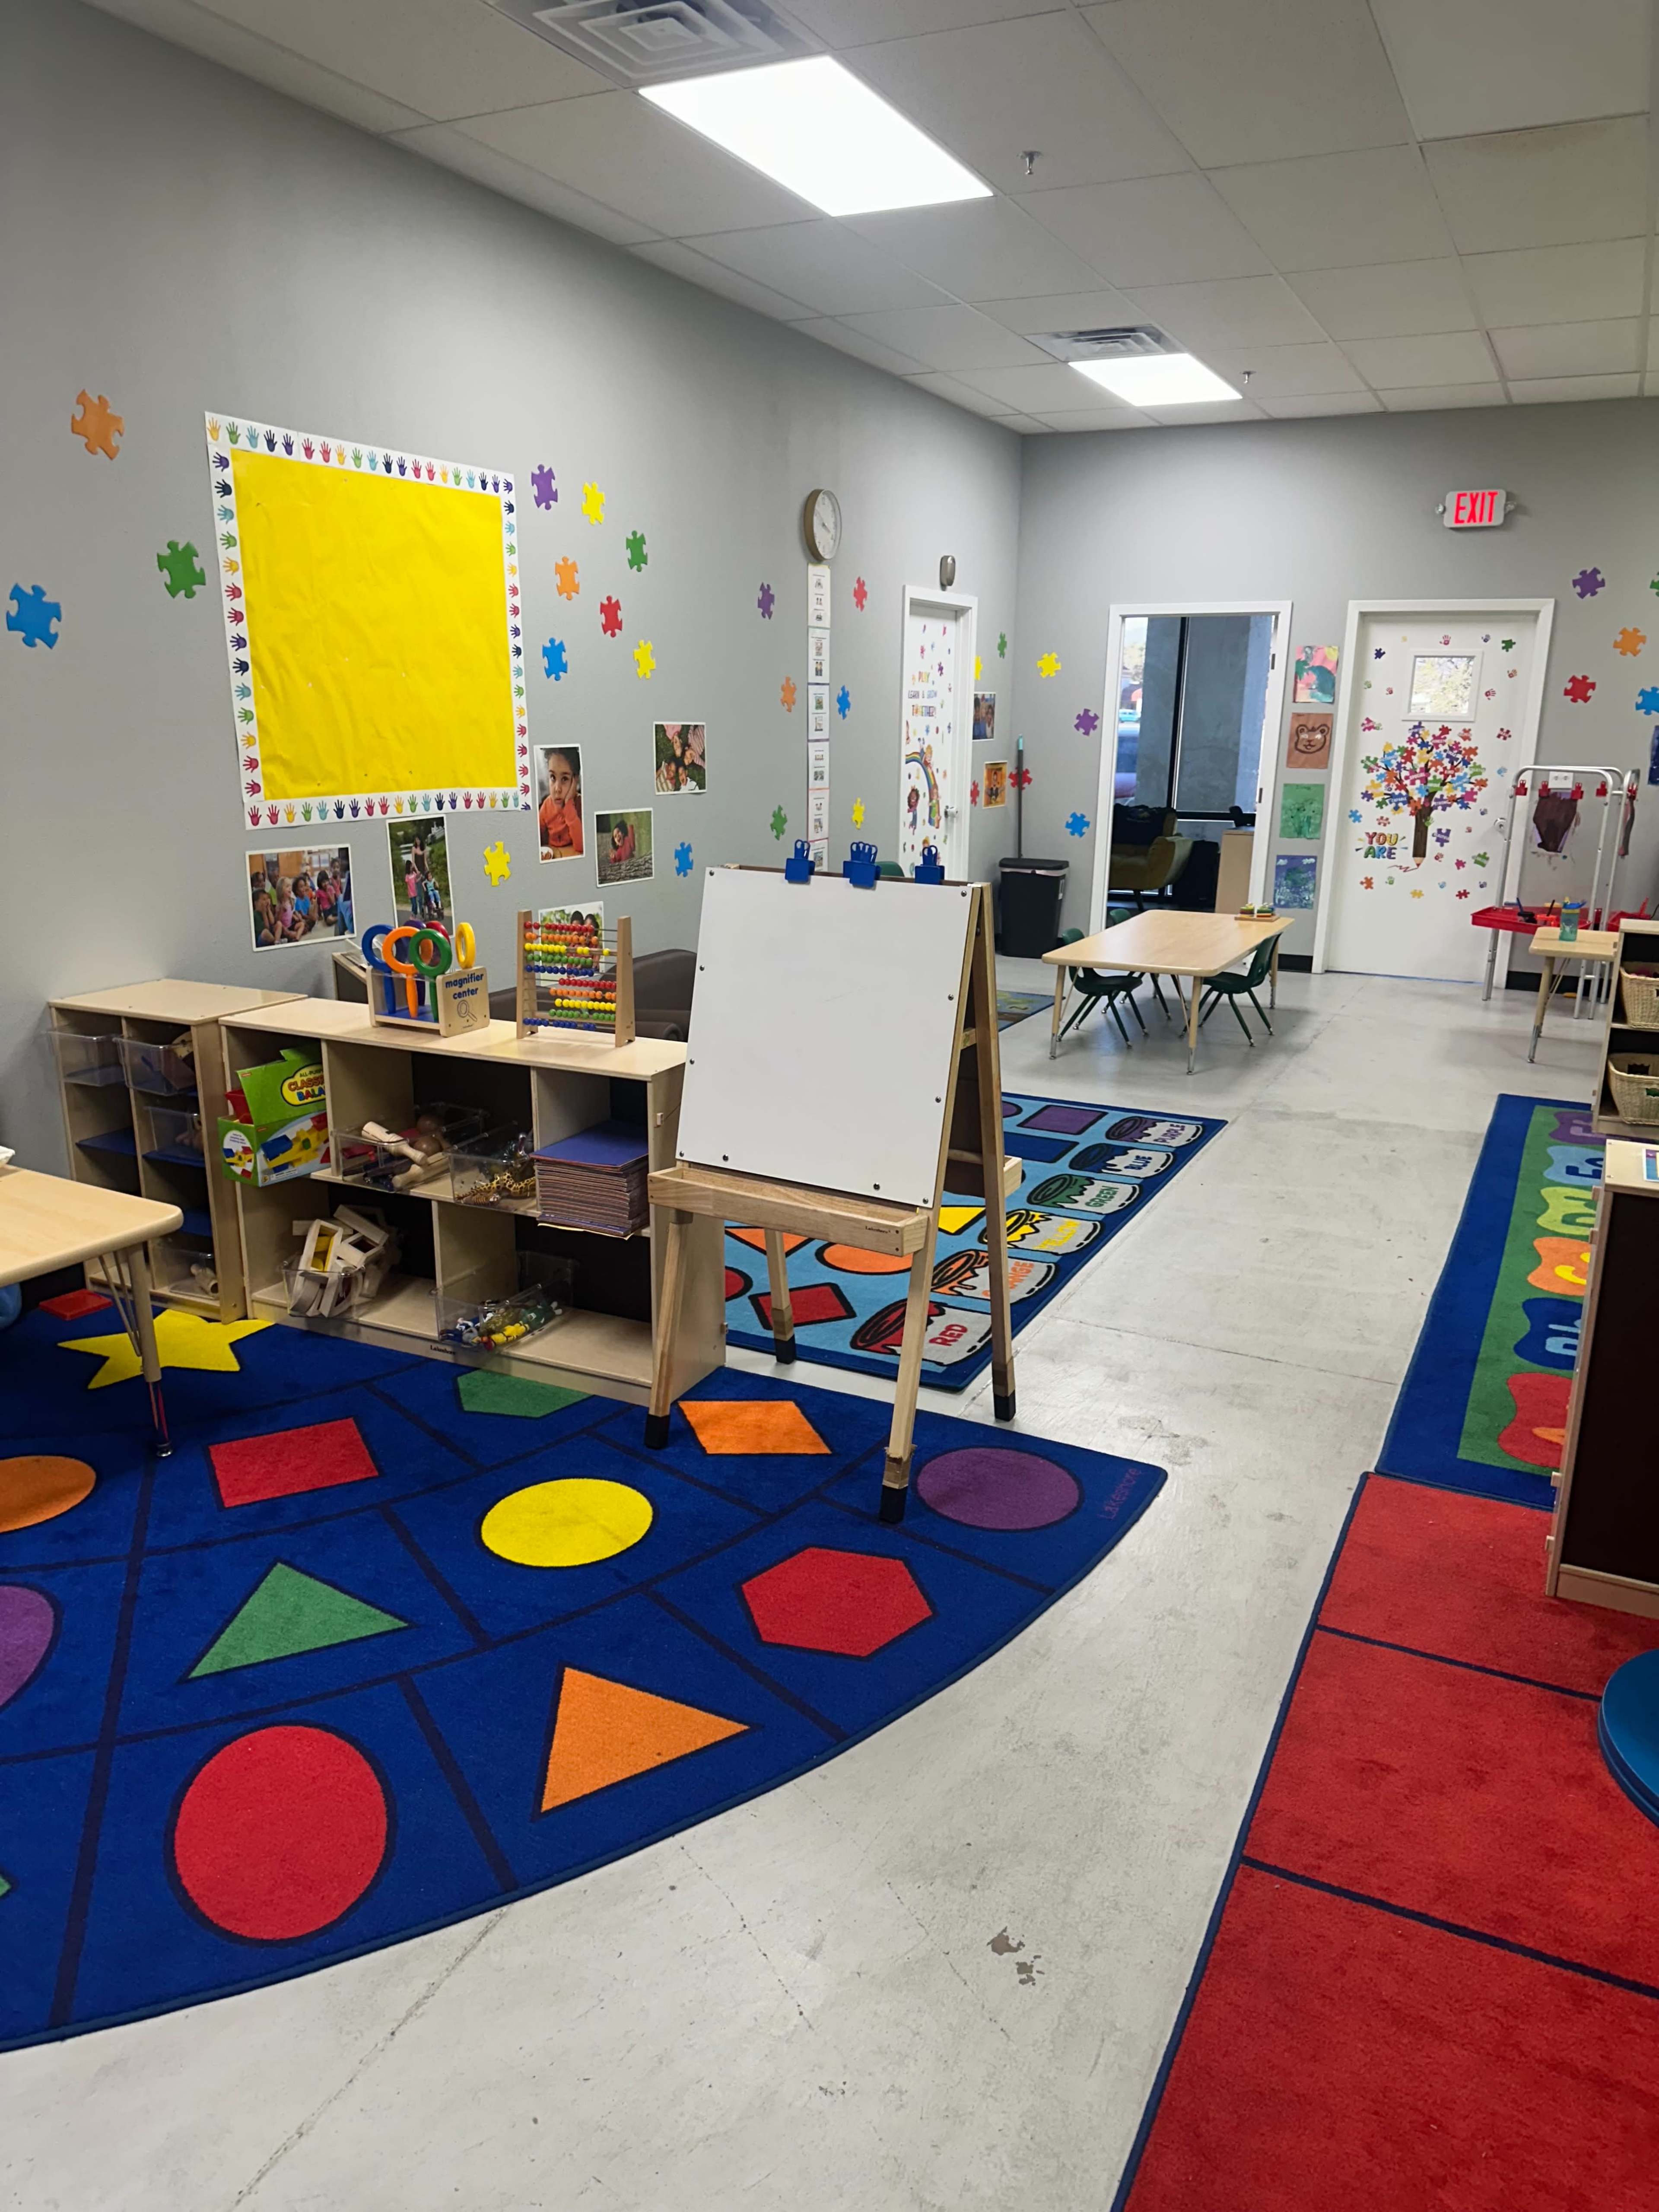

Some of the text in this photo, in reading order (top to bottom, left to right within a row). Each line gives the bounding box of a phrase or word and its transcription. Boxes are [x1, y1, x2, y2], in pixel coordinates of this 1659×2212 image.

[1454, 491, 1498, 524] EXIT
[1365, 832, 1398, 846] YOU
[1363, 845, 1397, 860] ARE
[445, 972, 484, 989] magnifier
[452, 987, 479, 1000] center
[297, 1086, 325, 1101] BALA
[1154, 1123, 1185, 1143] PURPLE
[1124, 1155, 1153, 1170] BLUE
[1085, 1185, 1119, 1208] GREEN
[1033, 1219, 1081, 1251] YELLOW
[928, 1324, 968, 1347] RED
